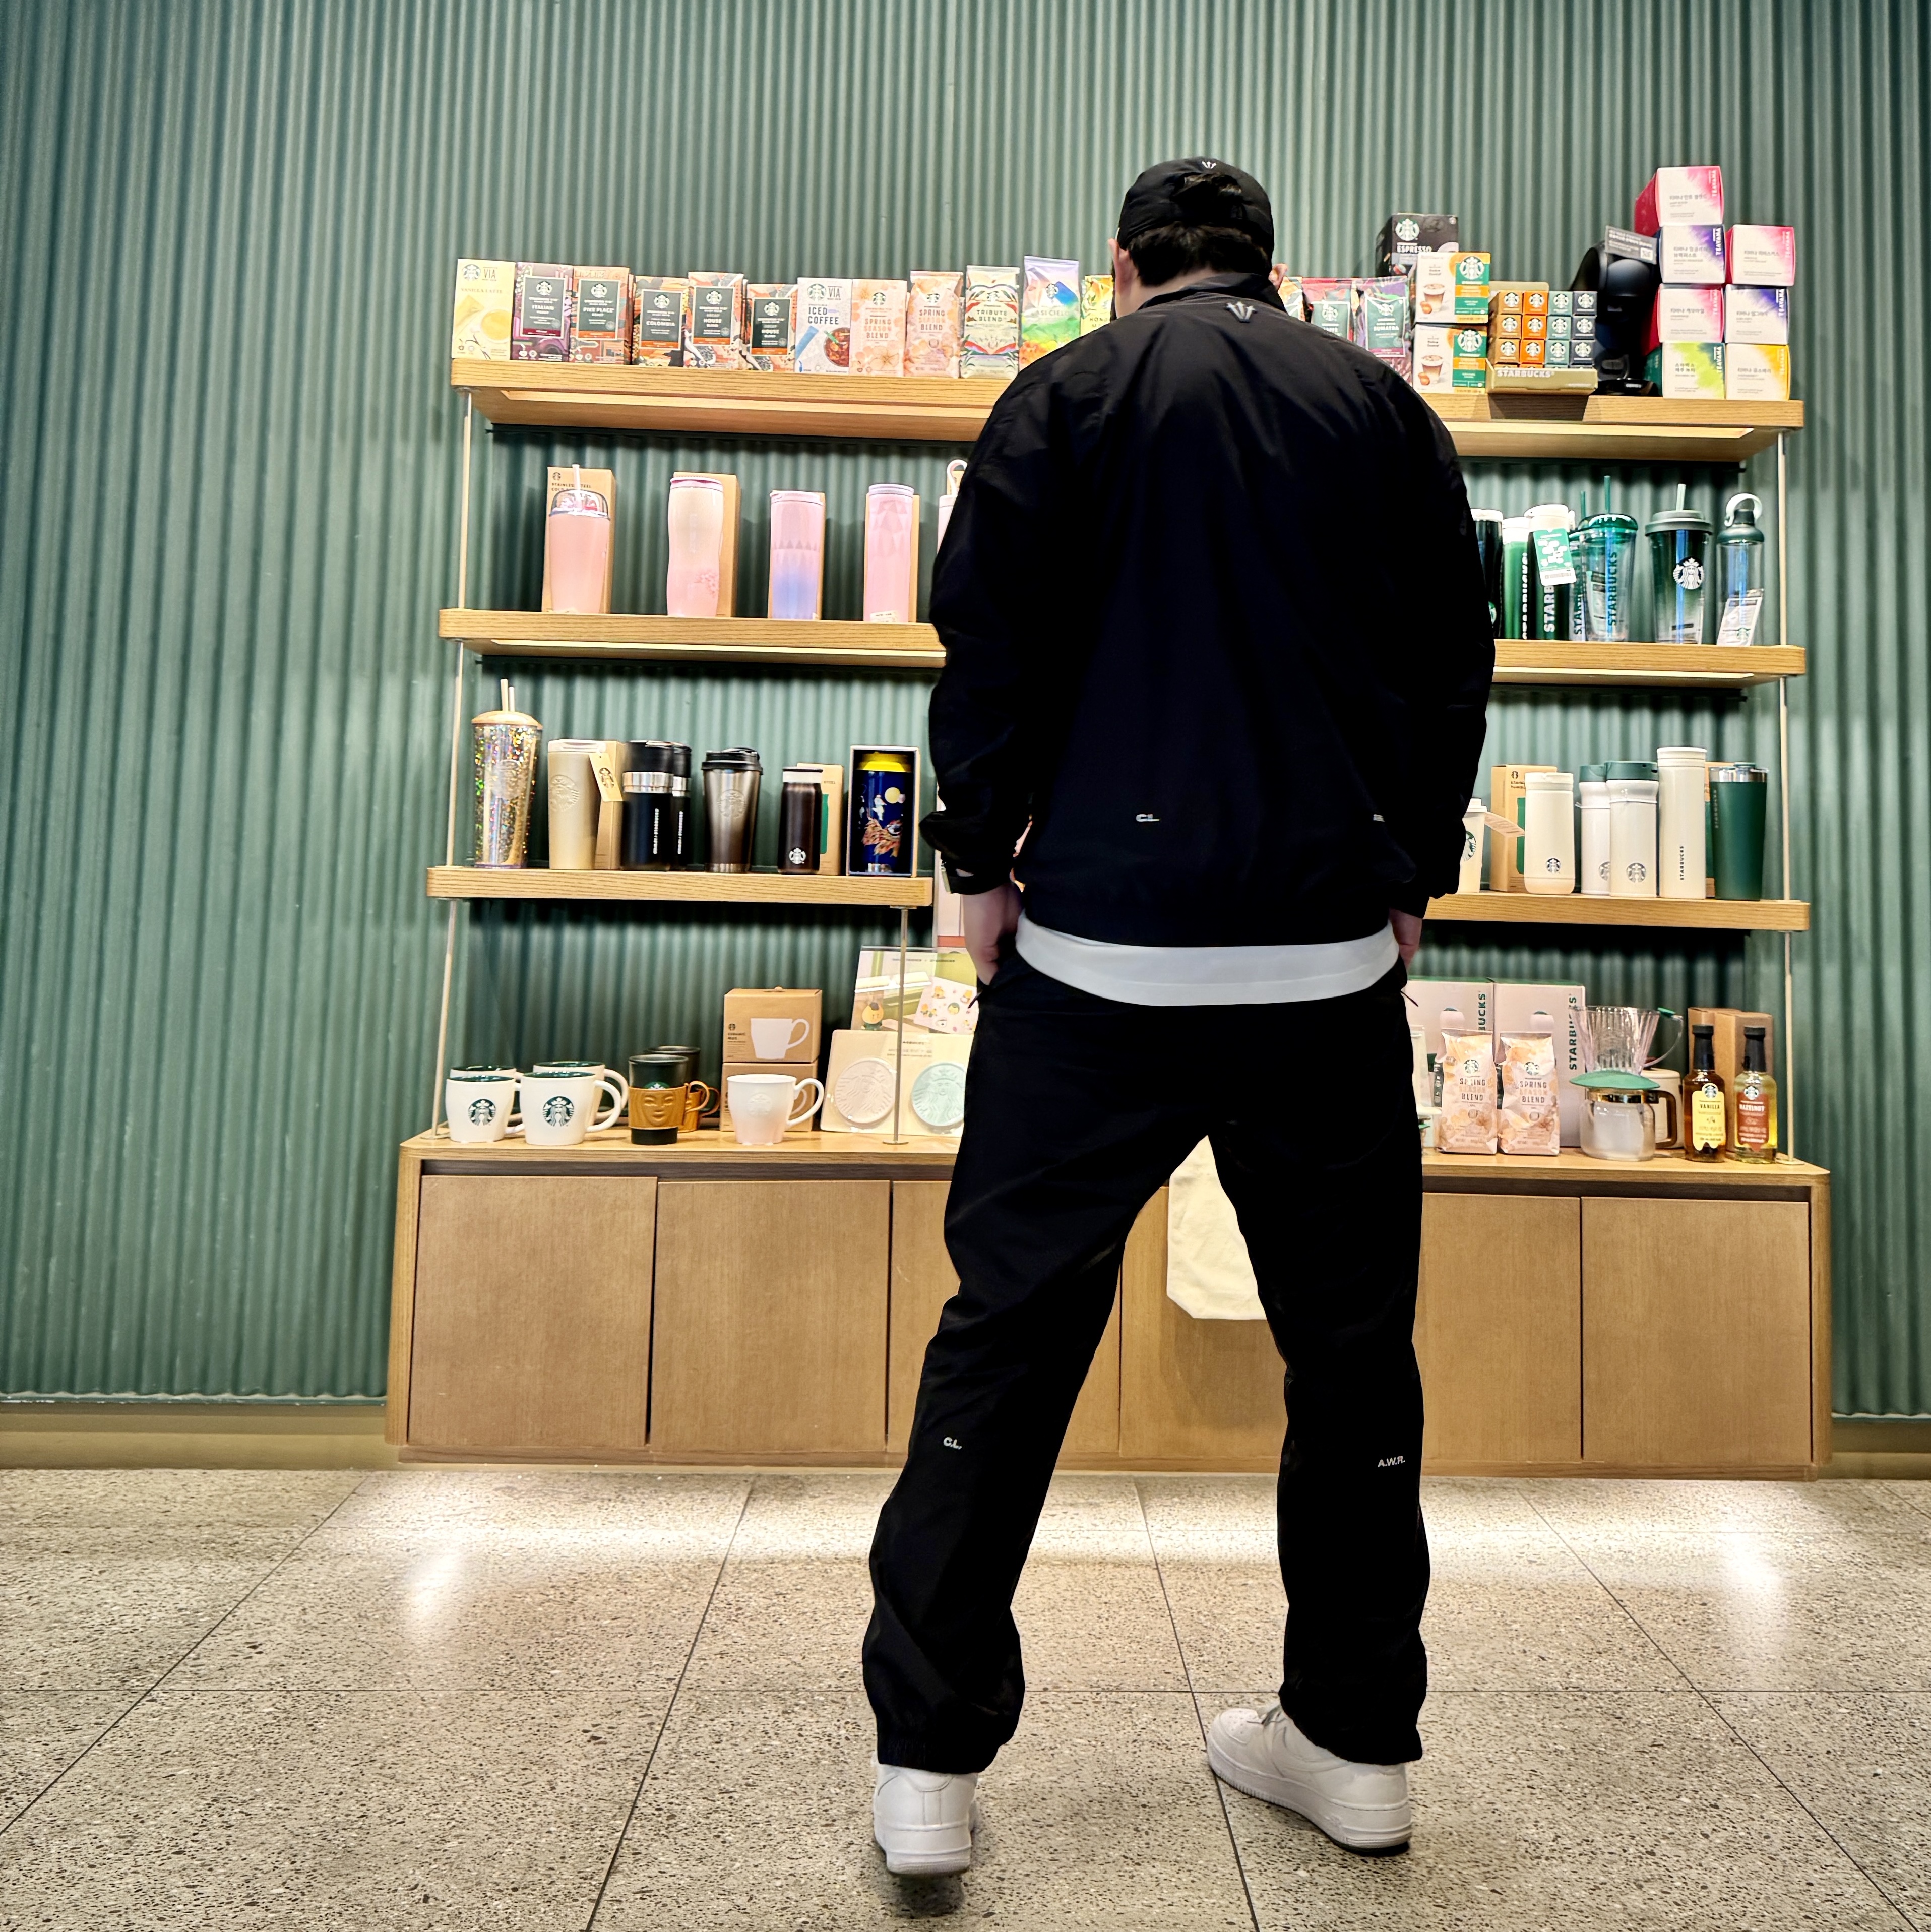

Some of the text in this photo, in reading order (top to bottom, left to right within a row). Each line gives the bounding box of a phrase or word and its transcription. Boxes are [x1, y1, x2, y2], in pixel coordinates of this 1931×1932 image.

[484, 269, 496, 279] VIA
[828, 288, 841, 298] VIA
[808, 307, 828, 315] ICED
[807, 316, 839, 325] COFFEE
[1497, 369, 1552, 378] STARBUCKS
[1607, 551, 1617, 626] STARBUCKS
[1569, 996, 1577, 1070] STARBS
[1520, 1081, 1547, 1089] SPRING
[1461, 1093, 1484, 1101] BLEND
[1739, 1104, 1765, 1112] HAZELNUT
[943, 1437, 963, 1450] C.L.
[1377, 1455, 1406, 1467] A.W.R.
